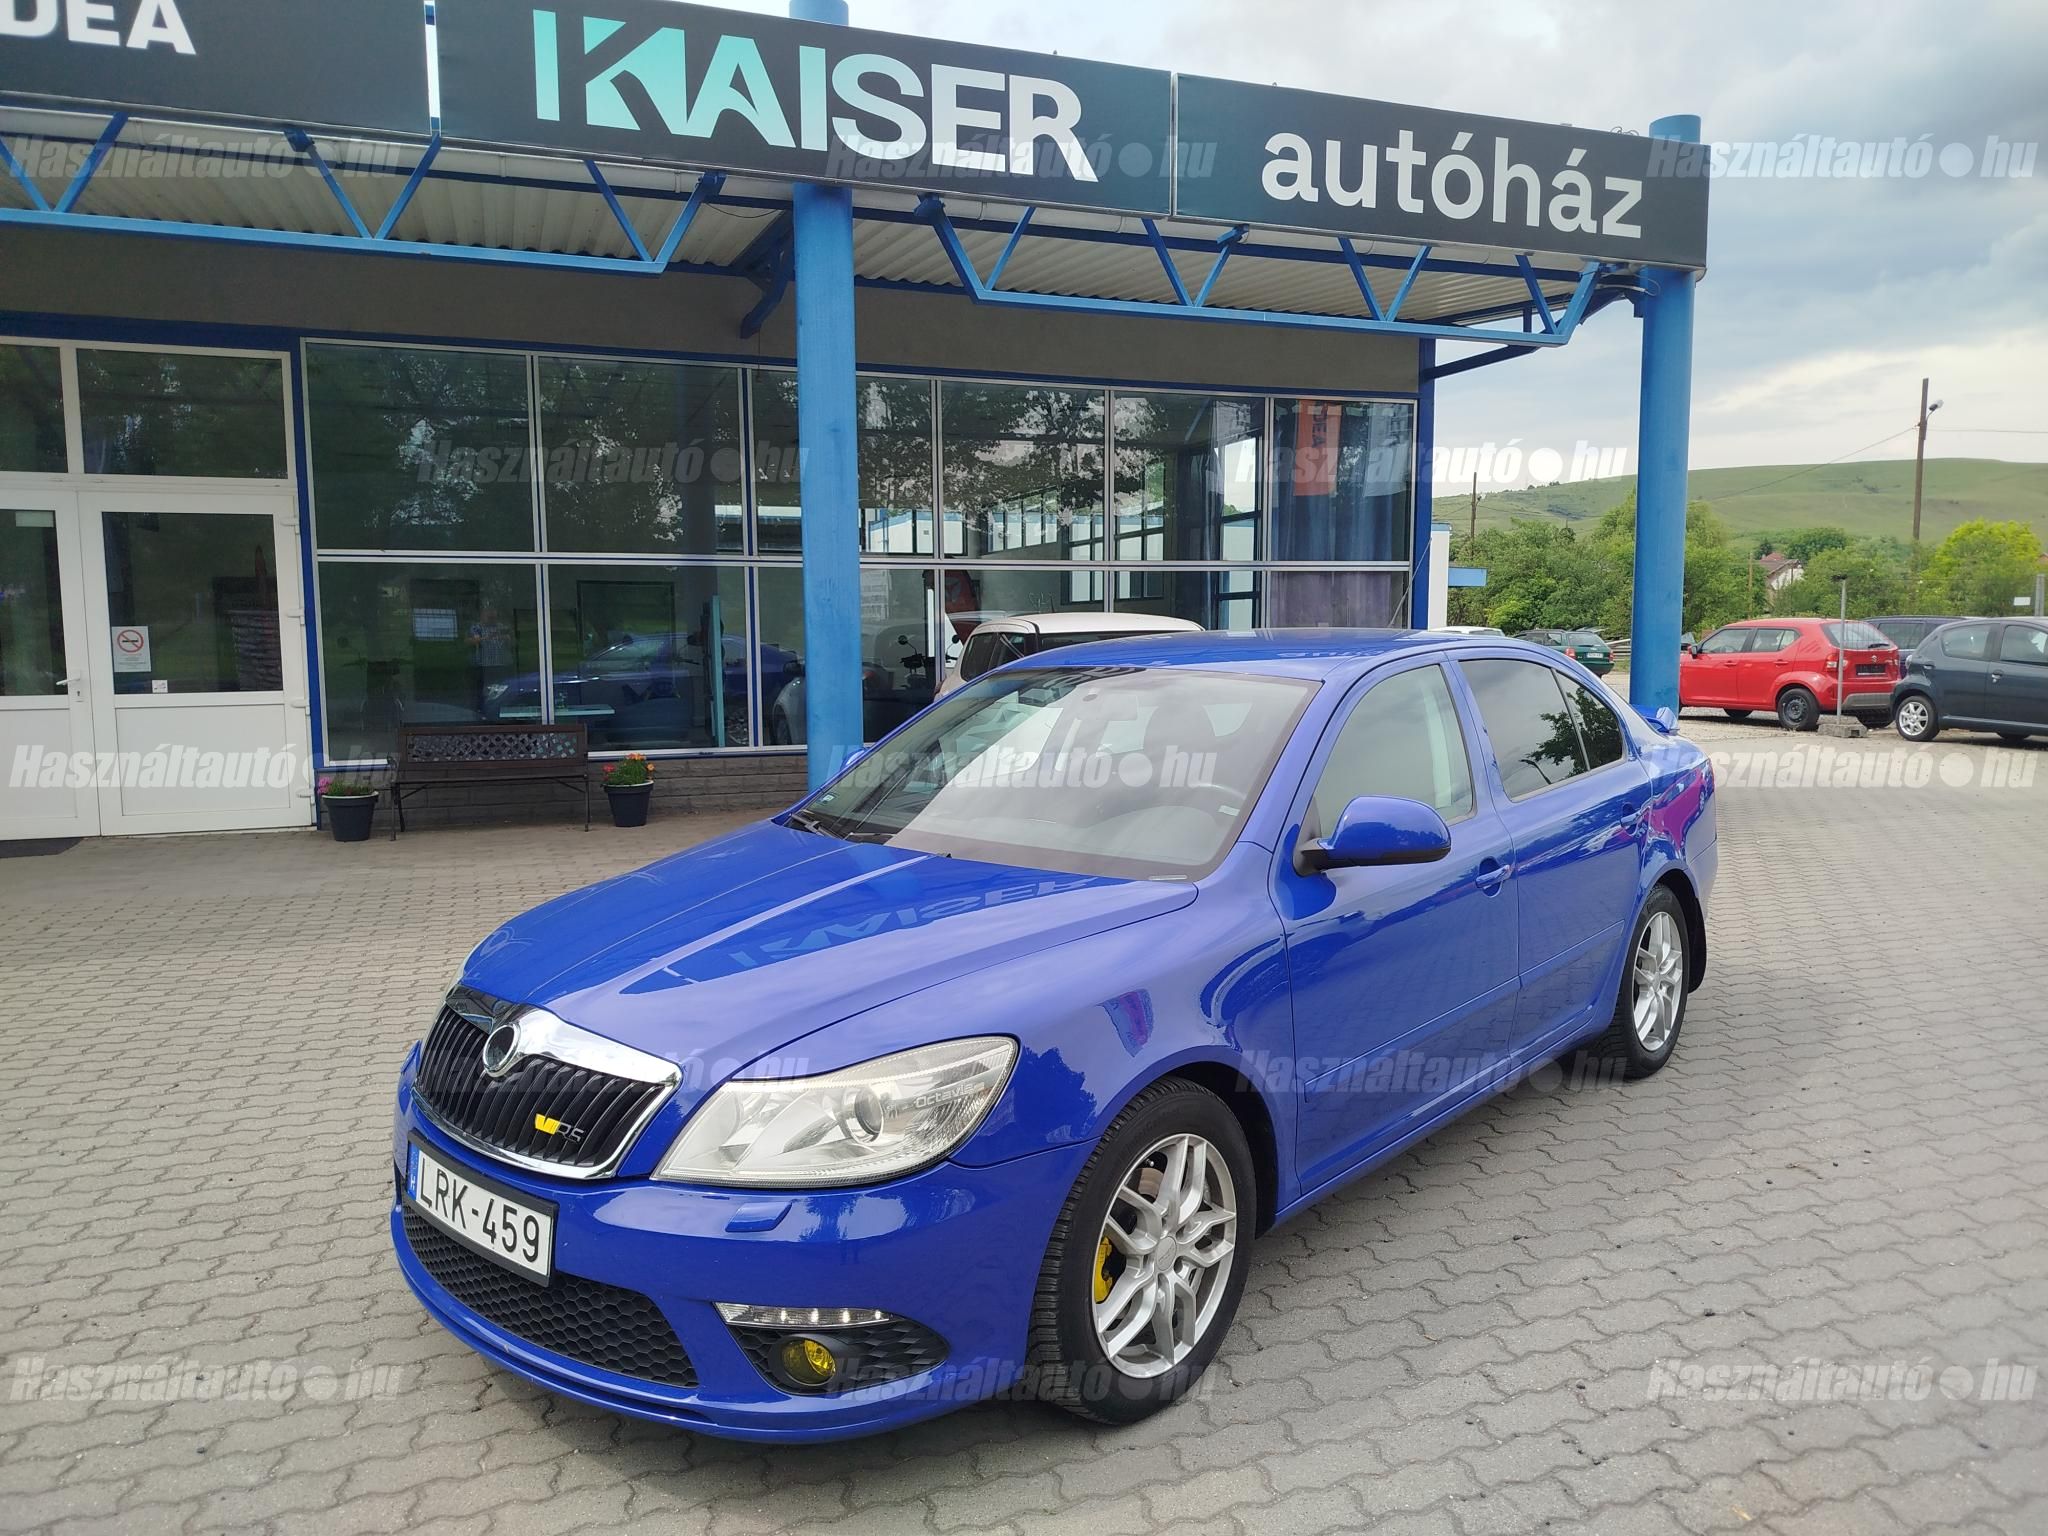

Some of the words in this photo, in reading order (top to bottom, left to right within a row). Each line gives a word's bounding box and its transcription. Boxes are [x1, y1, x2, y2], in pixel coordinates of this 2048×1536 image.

[533, 9, 1098, 182] KAISER
[1262, 130, 1643, 238] autóház
[420, 1157, 540, 1263] LRK-459
